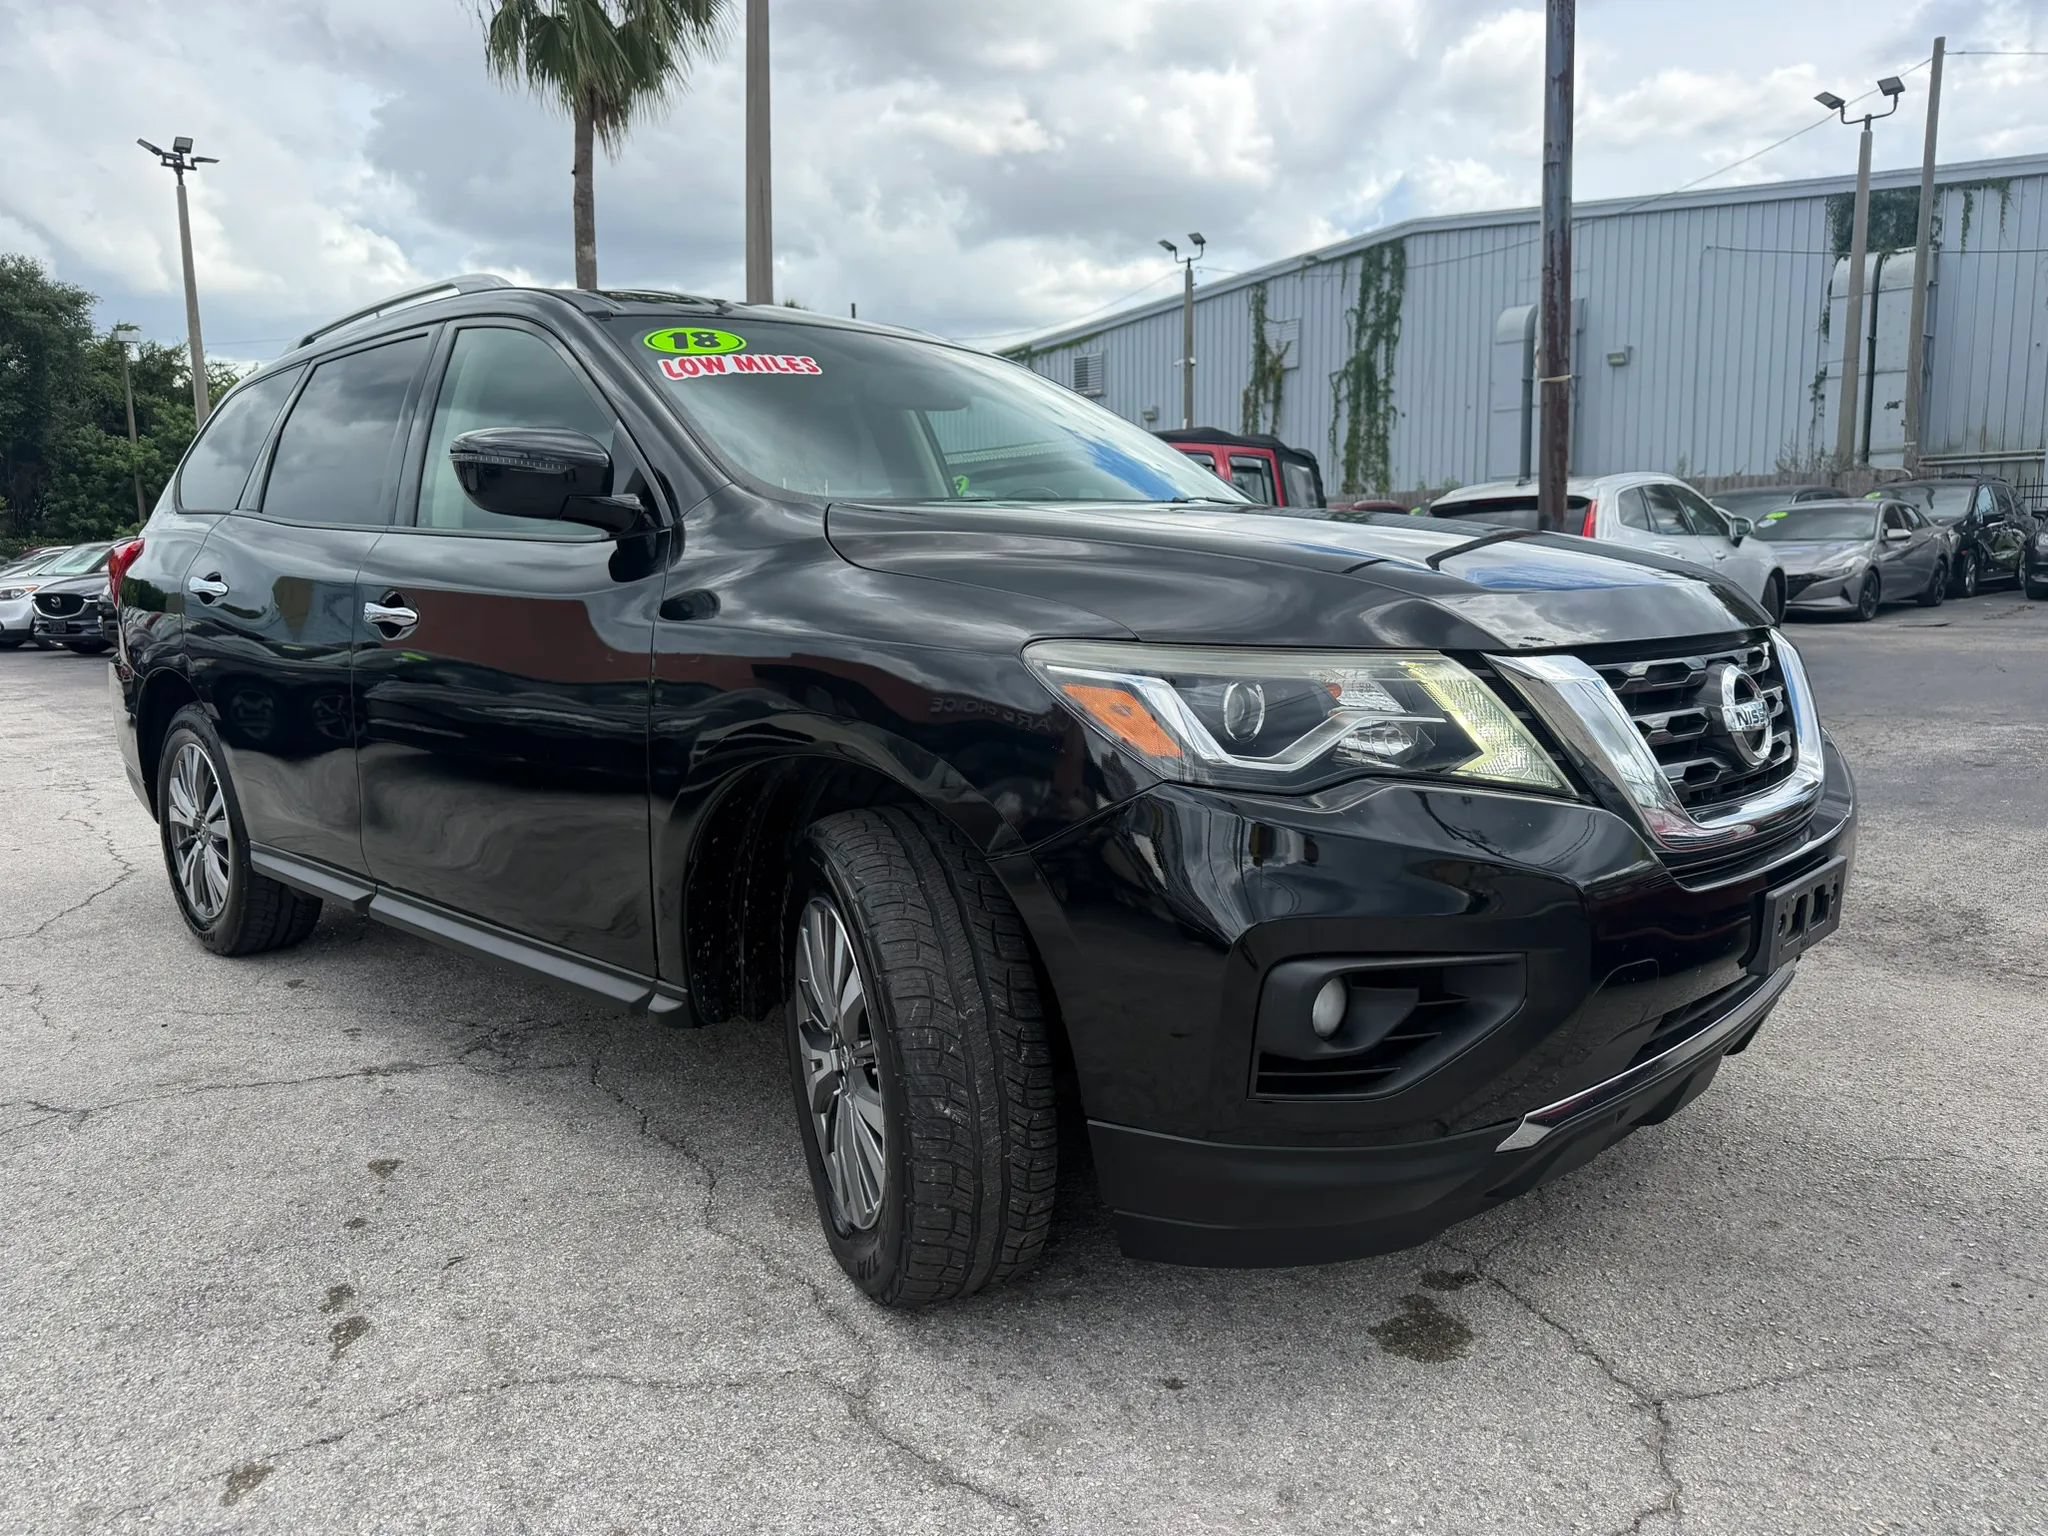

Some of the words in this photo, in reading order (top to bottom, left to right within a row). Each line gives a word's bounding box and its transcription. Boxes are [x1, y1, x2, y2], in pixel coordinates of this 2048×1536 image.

[667, 332, 721, 349] 18
[661, 356, 726, 378] LOW
[732, 355, 820, 373] MILES
[1735, 709, 1765, 727] NISS
